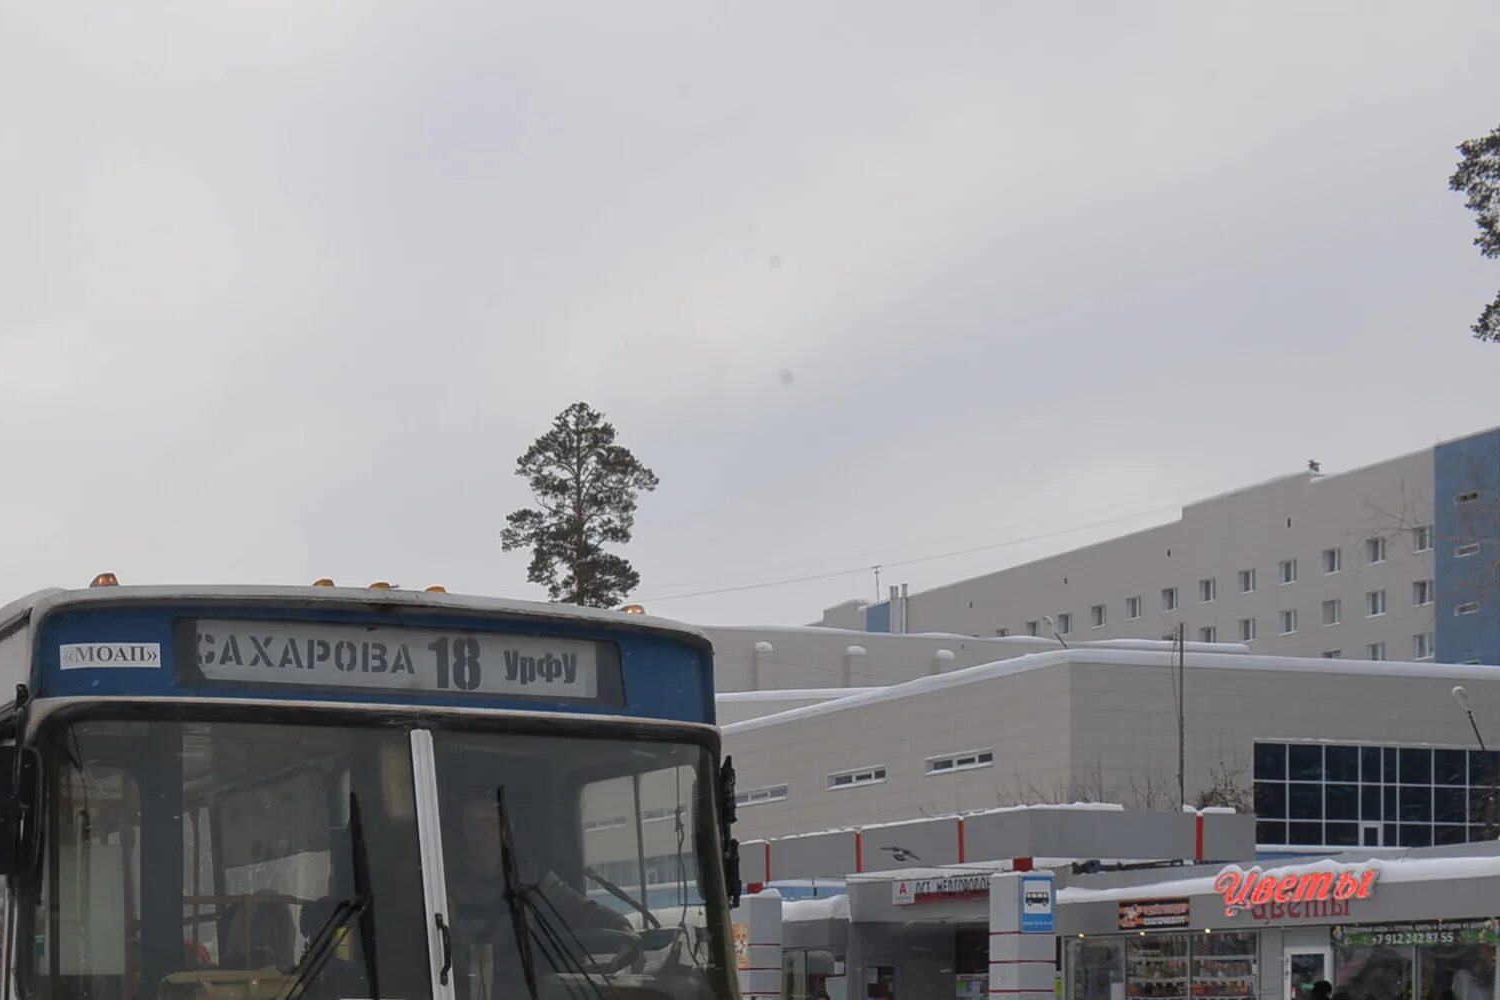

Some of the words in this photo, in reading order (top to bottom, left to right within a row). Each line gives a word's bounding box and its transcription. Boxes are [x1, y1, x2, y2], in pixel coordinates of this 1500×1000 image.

[199, 633, 415, 674] САХАРОВА
[428, 637, 481, 691] 18
[1215, 869, 1376, 917] Цветы
